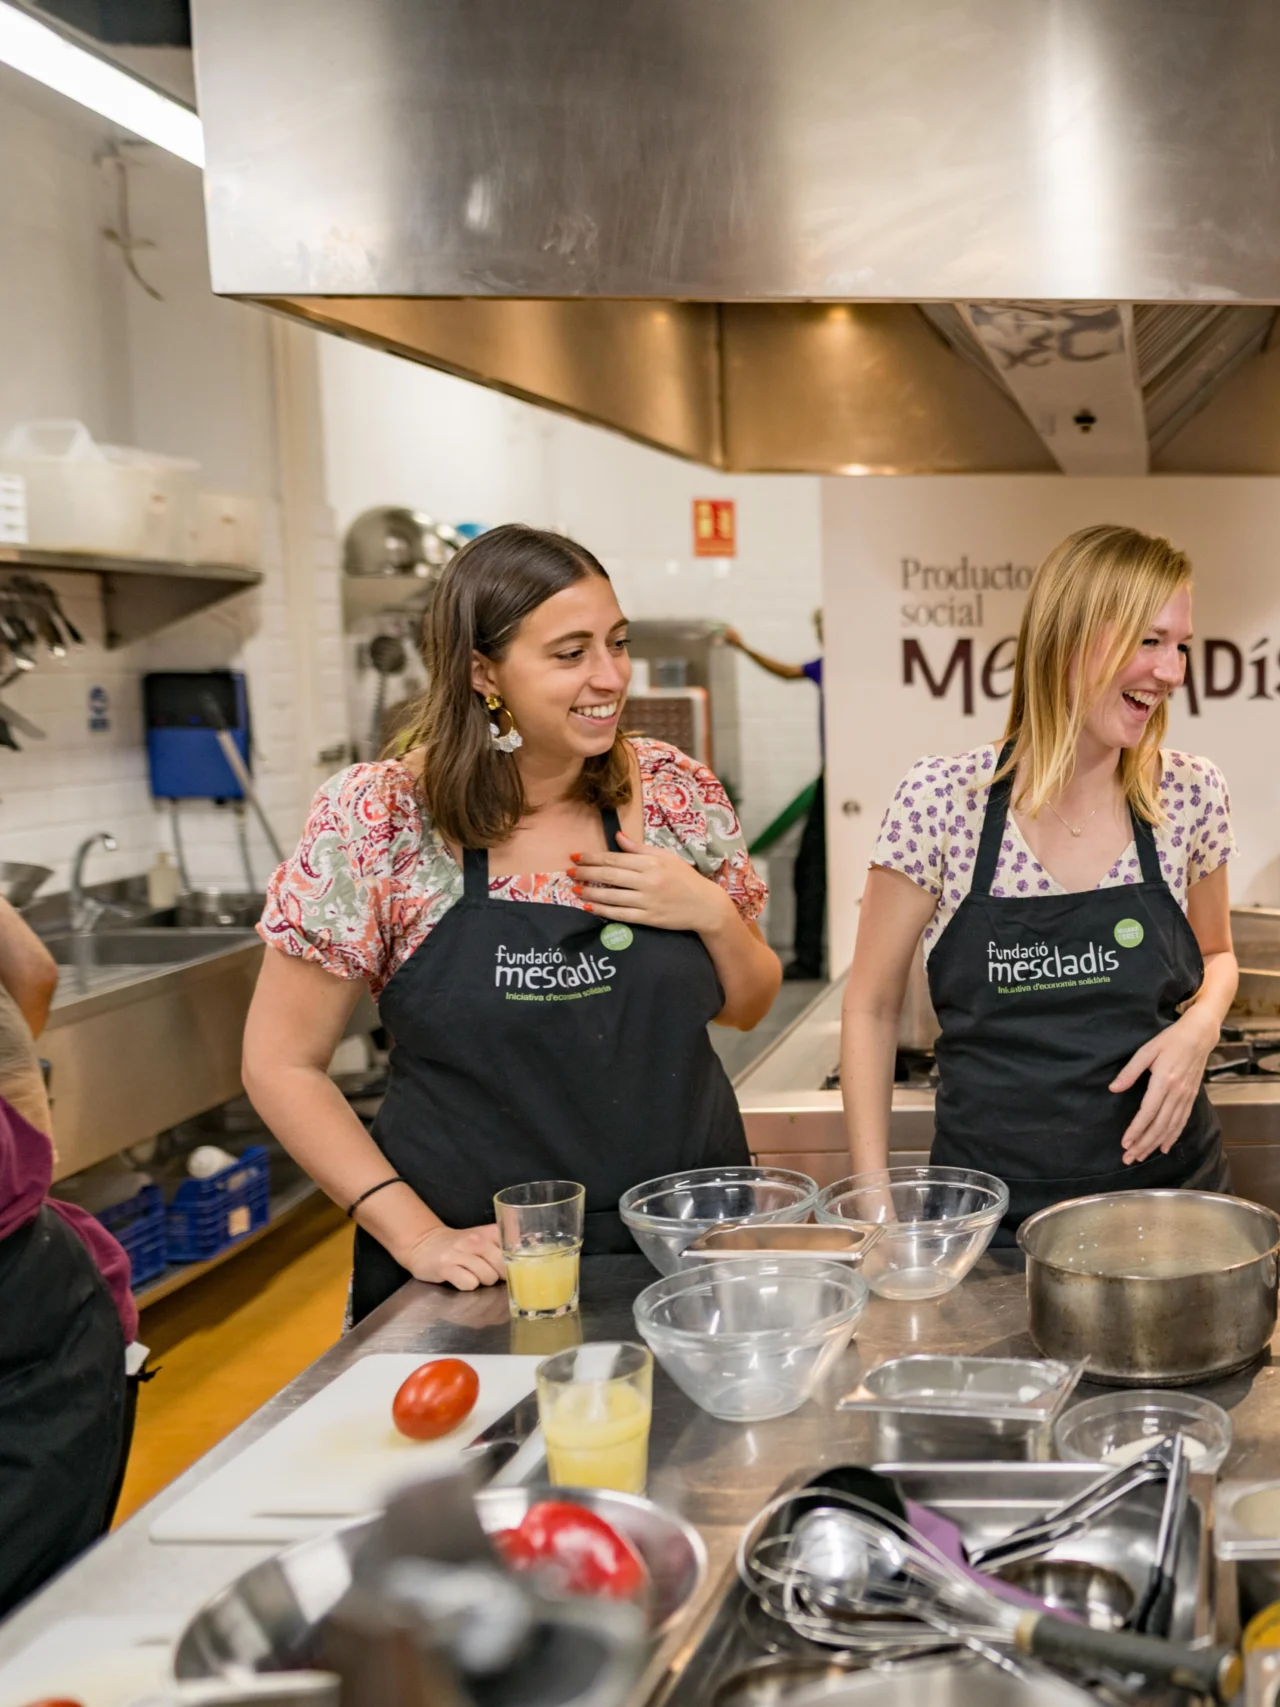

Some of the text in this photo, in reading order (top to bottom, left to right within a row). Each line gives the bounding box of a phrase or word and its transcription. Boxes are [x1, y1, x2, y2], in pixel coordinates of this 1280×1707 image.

[900, 592, 984, 627] social
[494, 944, 563, 965] fundació
[986, 941, 1049, 960] fundació
[988, 941, 1120, 983] mescladís
[494, 951, 617, 990] mescadís
[505, 991, 545, 1001] Iniciativa
